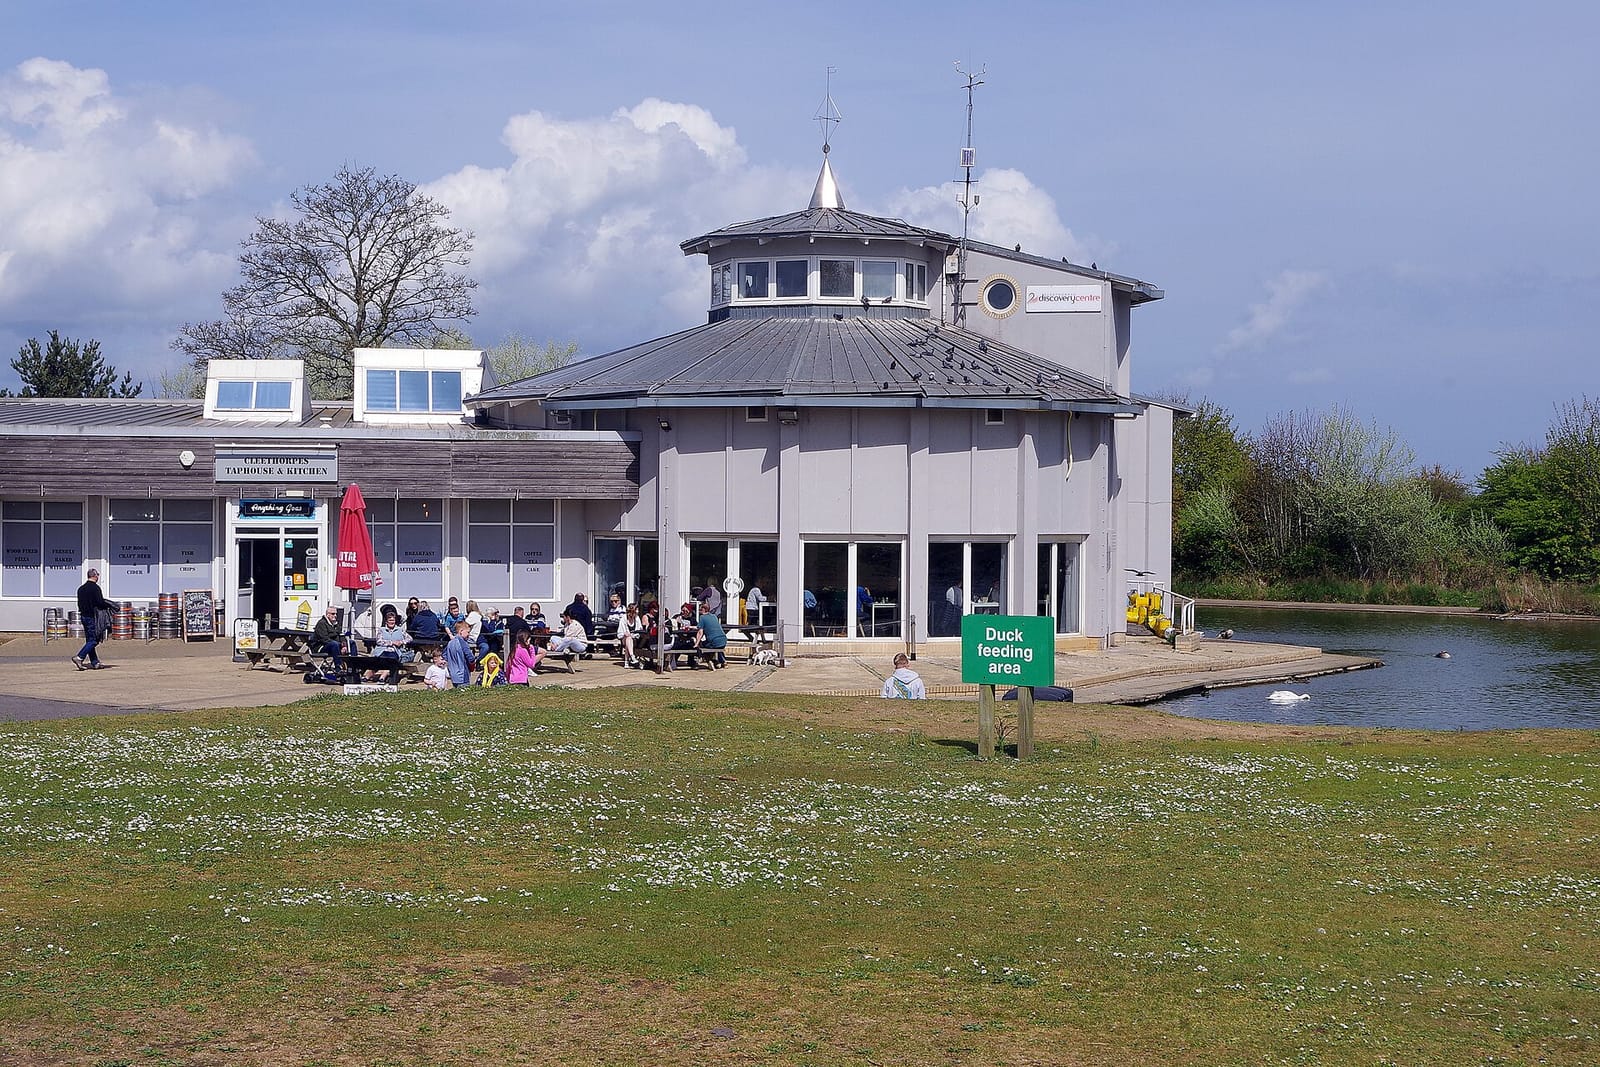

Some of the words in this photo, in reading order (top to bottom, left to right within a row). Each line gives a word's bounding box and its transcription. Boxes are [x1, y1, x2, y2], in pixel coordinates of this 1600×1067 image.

[244, 457, 309, 465] CLEETHORPES
[225, 467, 274, 475] TAPHOUSE
[277, 467, 283, 475] &
[286, 467, 328, 475] KITCHEN
[251, 503, 284, 513] Anything
[985, 627, 1024, 642] Duck
[977, 643, 1033, 662] feeding
[988, 663, 1021, 675] area
